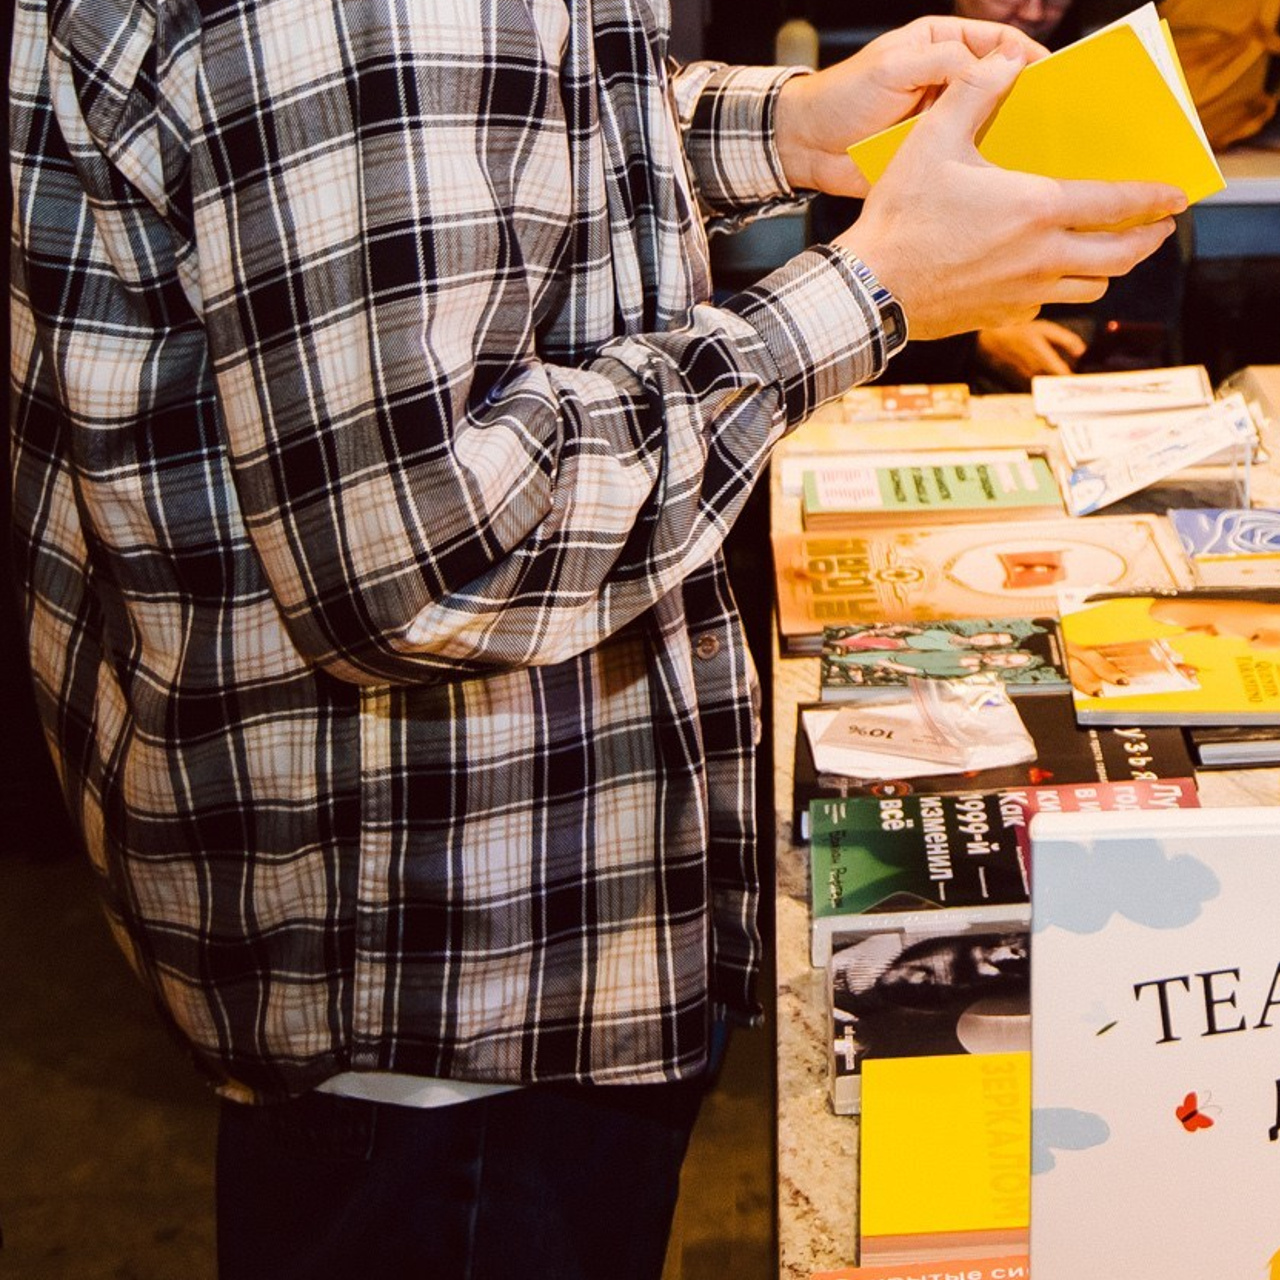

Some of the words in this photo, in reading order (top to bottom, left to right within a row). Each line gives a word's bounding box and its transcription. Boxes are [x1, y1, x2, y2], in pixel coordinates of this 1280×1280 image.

[848, 723, 896, 740] 10%
[999, 792, 1028, 827] Как
[1148, 784, 1182, 809] Лу
[880, 799, 914, 831] всё
[956, 793, 999, 855] 1999-й
[919, 796, 953, 880] изменил
[991, 1266, 1029, 1280] си
